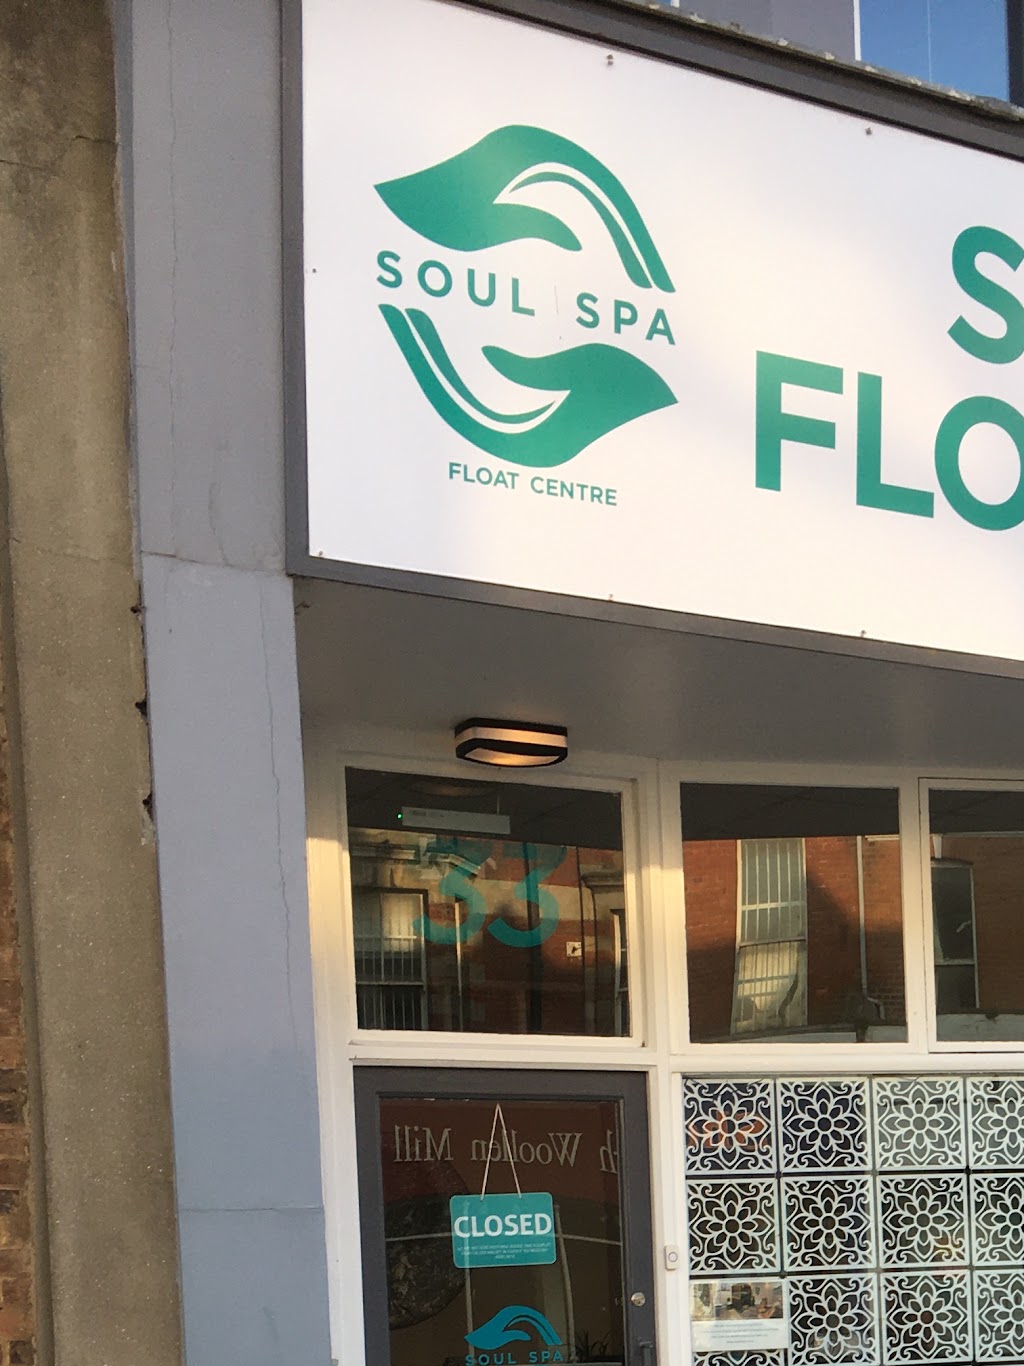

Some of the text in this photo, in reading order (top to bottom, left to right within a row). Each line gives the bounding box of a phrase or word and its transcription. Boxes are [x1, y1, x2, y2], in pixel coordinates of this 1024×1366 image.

[376, 250, 677, 345] SOUL SPA
[448, 462, 618, 506] FLOAT CENTRE
[411, 834, 568, 948] 33
[454, 1213, 553, 1238] CLOSED
[465, 1350, 564, 1366] SOUL SPA
